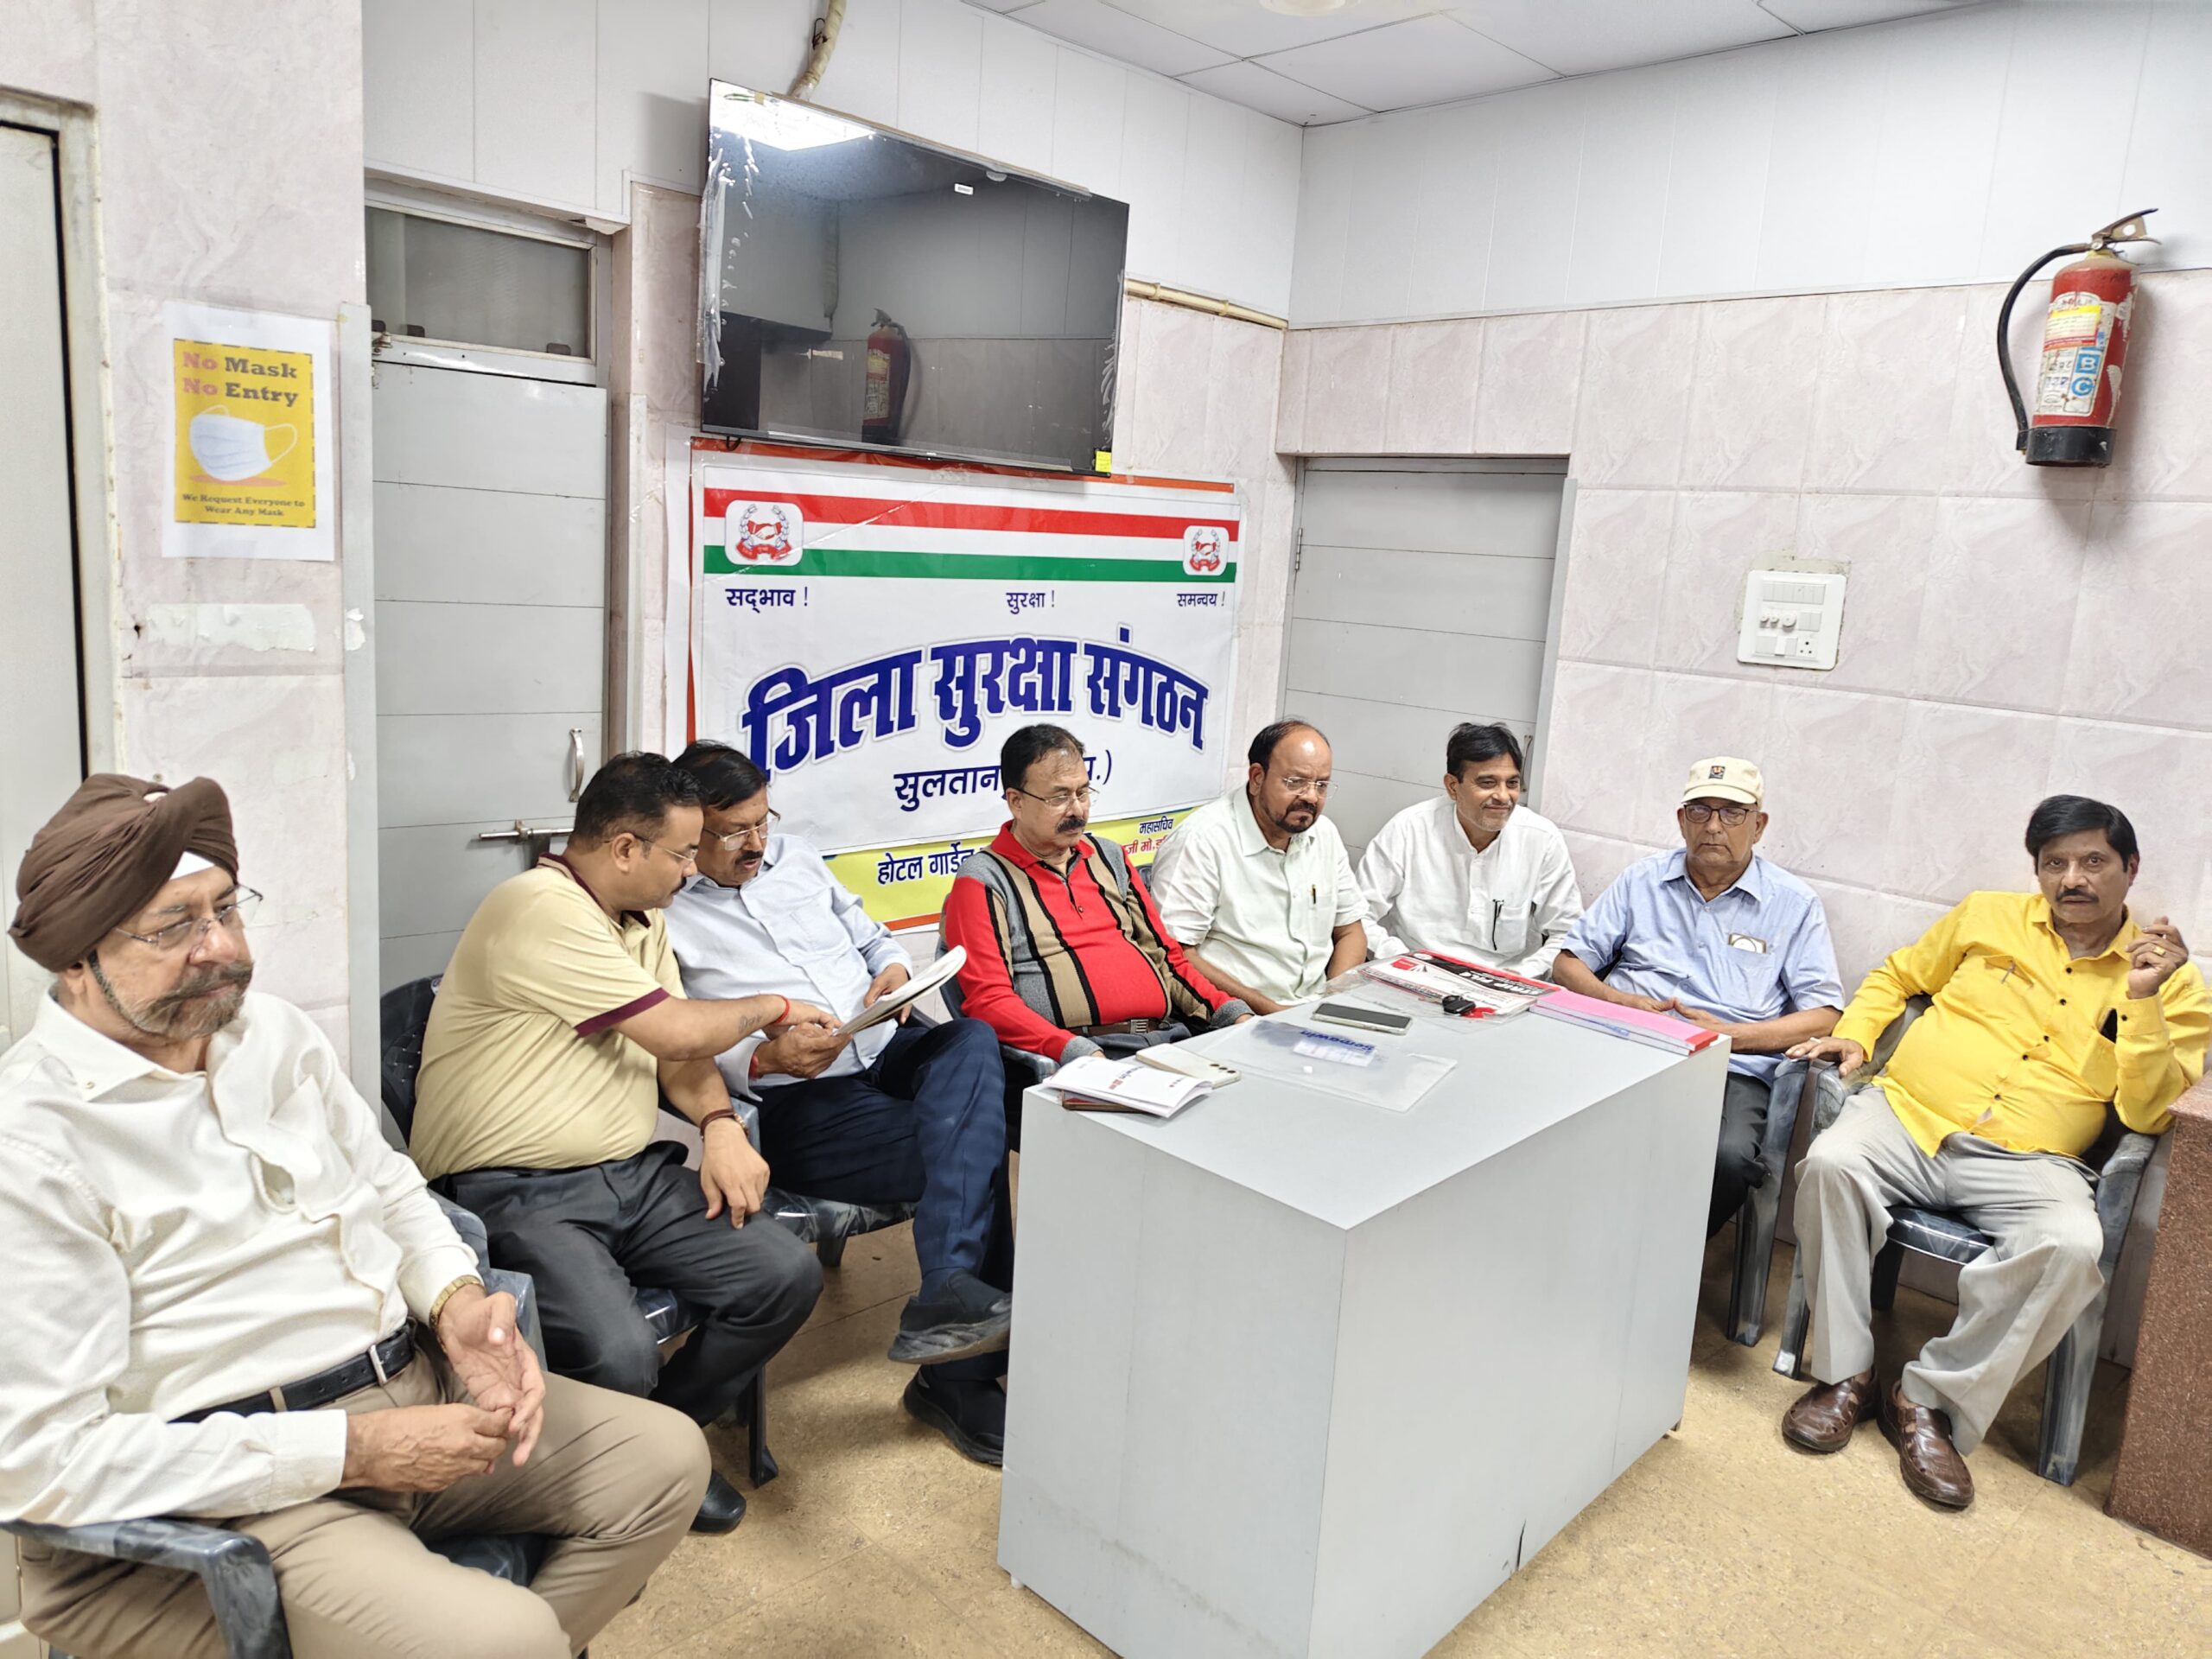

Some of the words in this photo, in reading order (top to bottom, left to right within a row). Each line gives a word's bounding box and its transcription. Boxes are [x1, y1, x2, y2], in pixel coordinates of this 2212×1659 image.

[182, 352, 218, 371] No
[225, 357, 297, 378] Mask
[182, 378, 218, 397] No
[225, 382, 298, 407] Entry
[182, 493, 198, 502] We
[200, 494, 242, 504] Request
[245, 497, 291, 506] Everyone
[205, 505, 232, 514] Wear
[234, 506, 255, 516] Any
[1006, 592, 1046, 614] सुरक्षा
[1177, 594, 1218, 607] समन्वय
[742, 650, 922, 781] जिला
[931, 637, 1077, 746] सुरक्षा
[1084, 626, 1210, 750] संगठन
[877, 852, 923, 885] होटल
